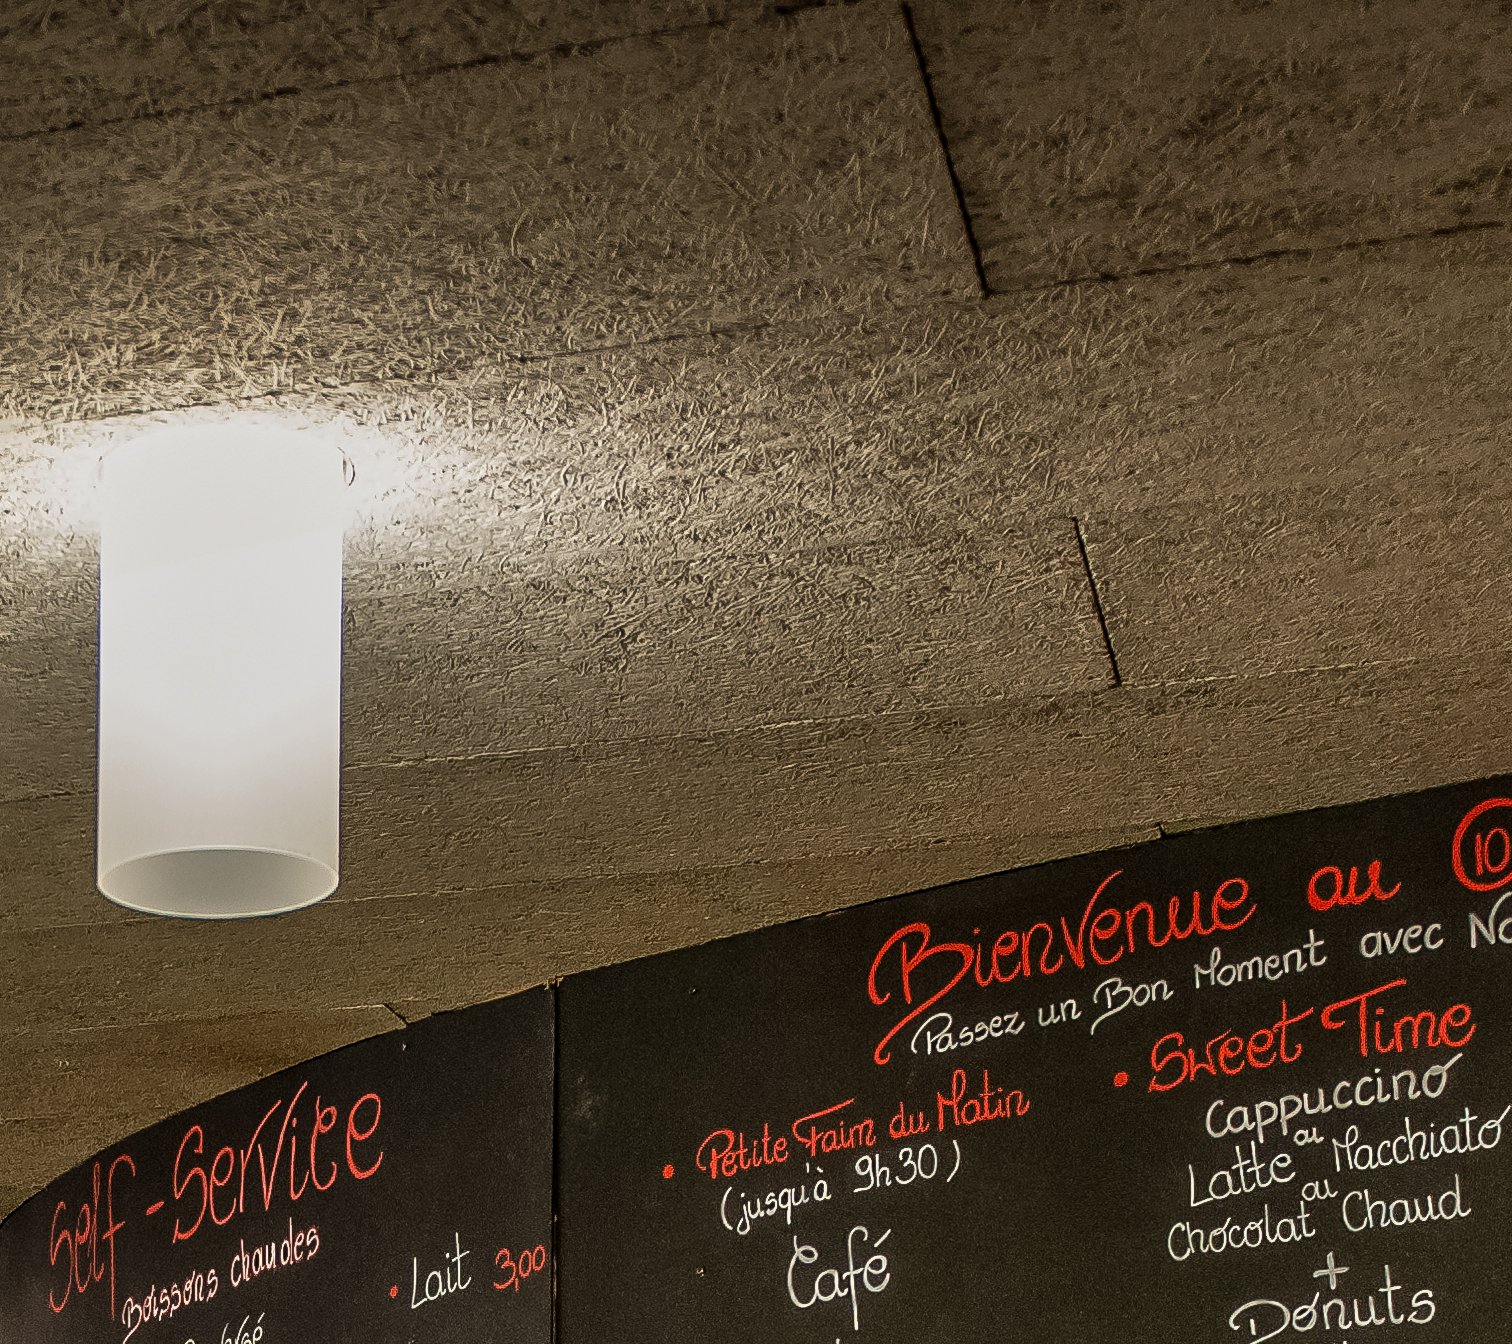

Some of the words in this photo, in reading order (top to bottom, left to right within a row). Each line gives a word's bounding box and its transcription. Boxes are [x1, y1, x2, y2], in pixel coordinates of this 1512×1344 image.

[866, 869, 1270, 1078] Bienvenue
[1306, 859, 1402, 912] au
[910, 1011, 1026, 1056] Passez
[1037, 998, 1082, 1027] un
[1090, 977, 1174, 1036] Bon
[1193, 928, 1328, 990] Moment
[1360, 923, 1444, 959] avec
[1147, 1000, 1315, 1093] Sweet
[1319, 978, 1477, 1057] Time
[695, 1122, 790, 1180] Petite
[790, 1098, 877, 1157] Faim
[888, 1102, 931, 1140] du
[935, 1068, 1031, 1132] Matin
[1205, 1052, 1464, 1147] Cappuccino
[1294, 1124, 1325, 1145] ou
[1187, 1139, 1297, 1208] Latte
[1331, 1104, 1512, 1173] Macchiato
[1302, 1178, 1338, 1202] ou
[230, 1216, 320, 1288] chaudes
[1167, 1198, 1318, 1263] Chocolat
[1341, 1173, 1472, 1233] Chaud
[410, 1231, 473, 1310] Lait
[786, 1225, 892, 1332] Café
